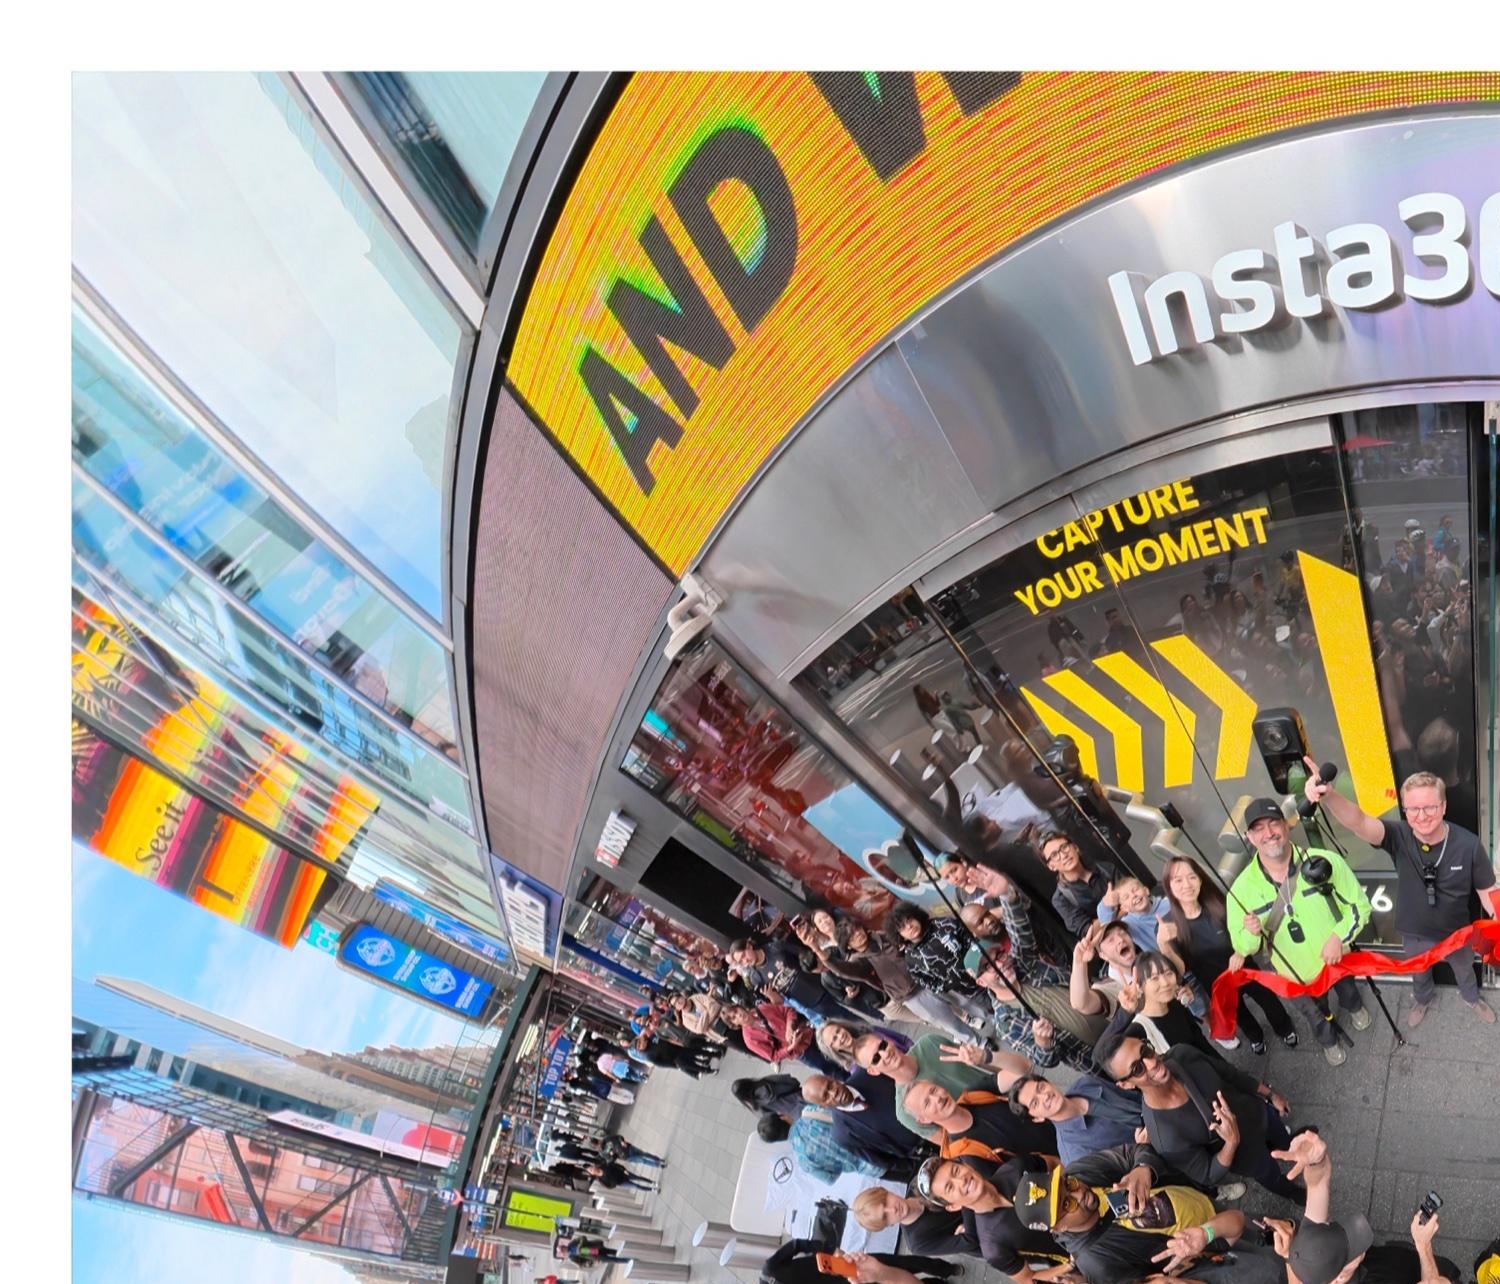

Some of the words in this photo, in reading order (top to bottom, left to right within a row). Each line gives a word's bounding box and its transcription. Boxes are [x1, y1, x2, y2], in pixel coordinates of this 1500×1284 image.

[576, 121, 798, 497] AND
[1014, 566, 1104, 617] YOUR
[1103, 507, 1270, 583] MOMENT
[1036, 477, 1199, 560] CAPTURE
[134, 827, 178, 874] See
